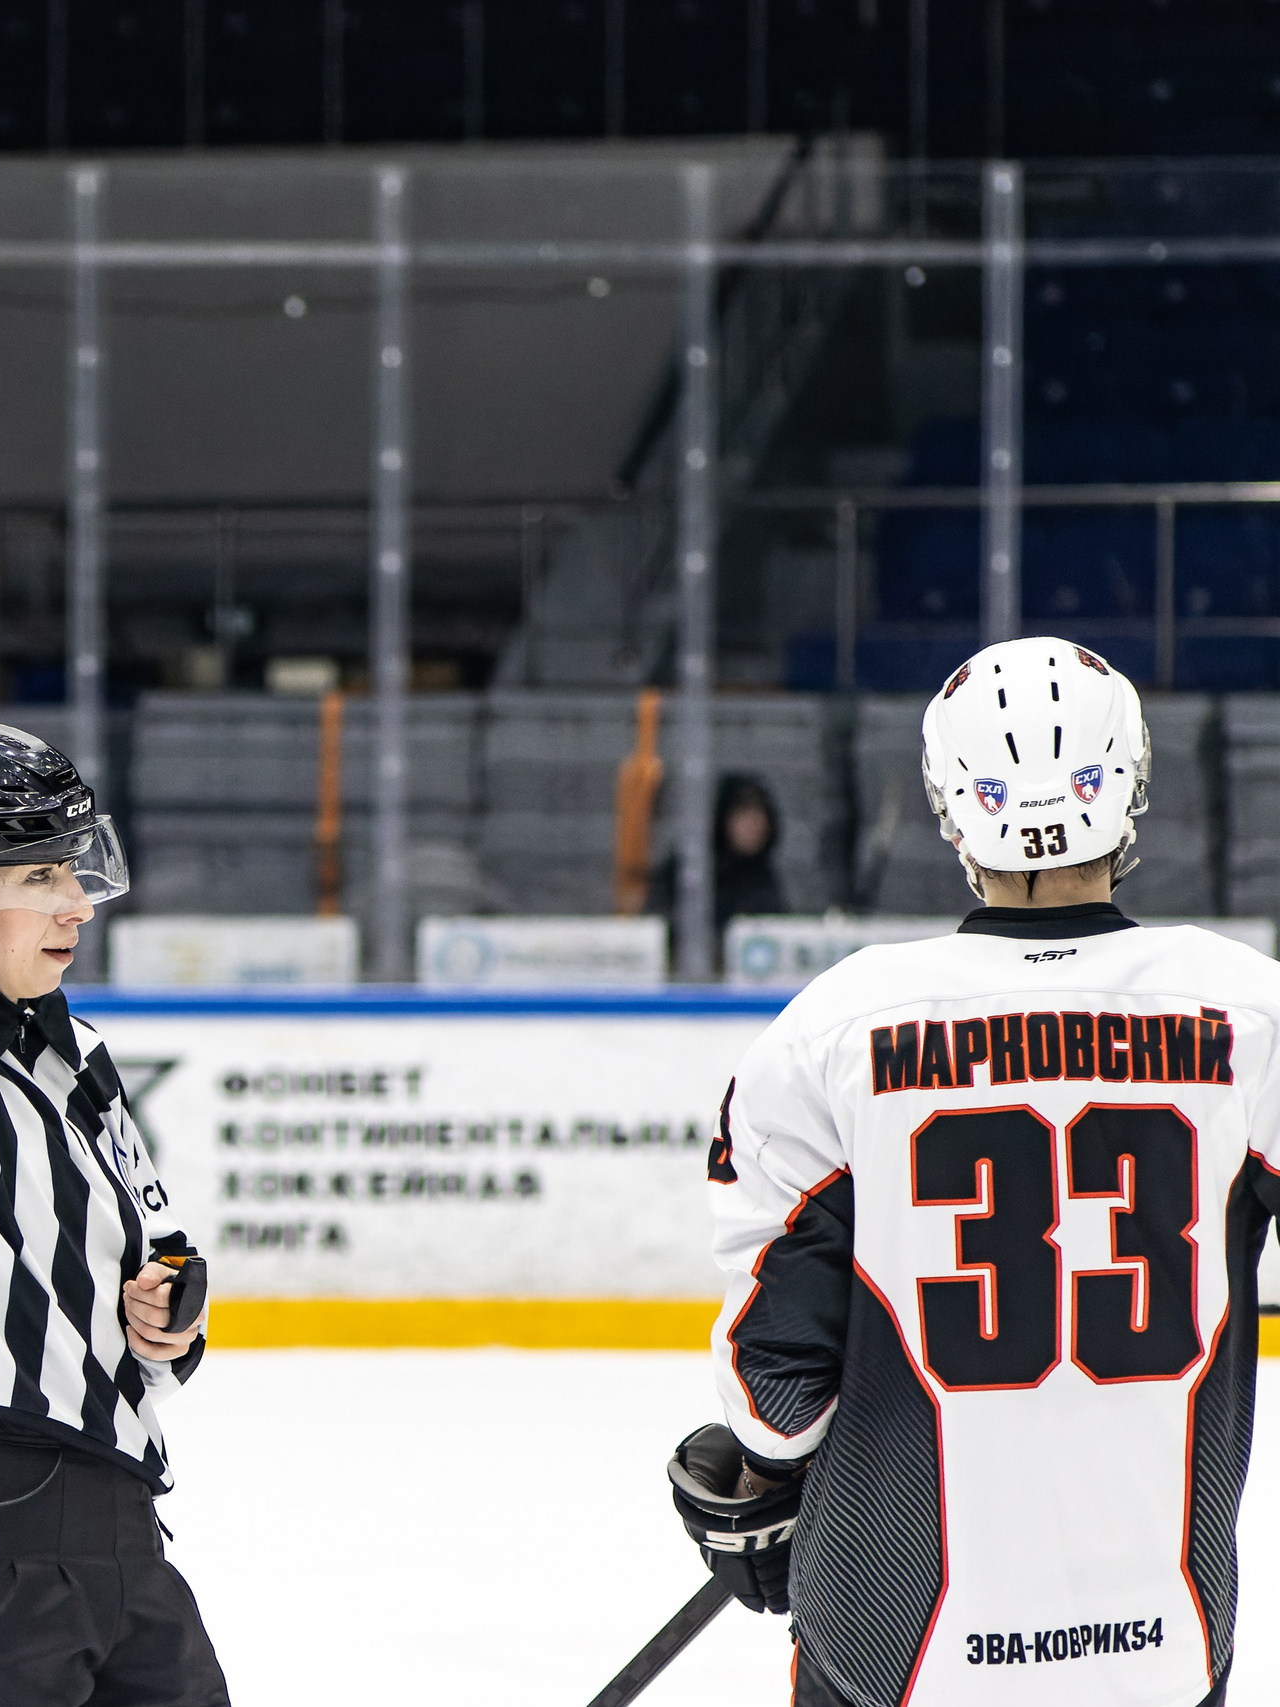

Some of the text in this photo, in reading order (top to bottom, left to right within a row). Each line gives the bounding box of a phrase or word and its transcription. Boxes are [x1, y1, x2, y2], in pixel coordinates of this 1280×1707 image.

[977, 783, 1002, 794] СХЛ
[1075, 769, 1099, 785] СХЛ
[1020, 823, 1069, 859] 33
[870, 1006, 1234, 1096] МАРКОВСКИЙ
[219, 1115, 703, 1149] КОНТИНЕНТАЛЬНА
[910, 1102, 1206, 1393] 33
[966, 1617, 1164, 1665] ЭВА-КОВРИК54
